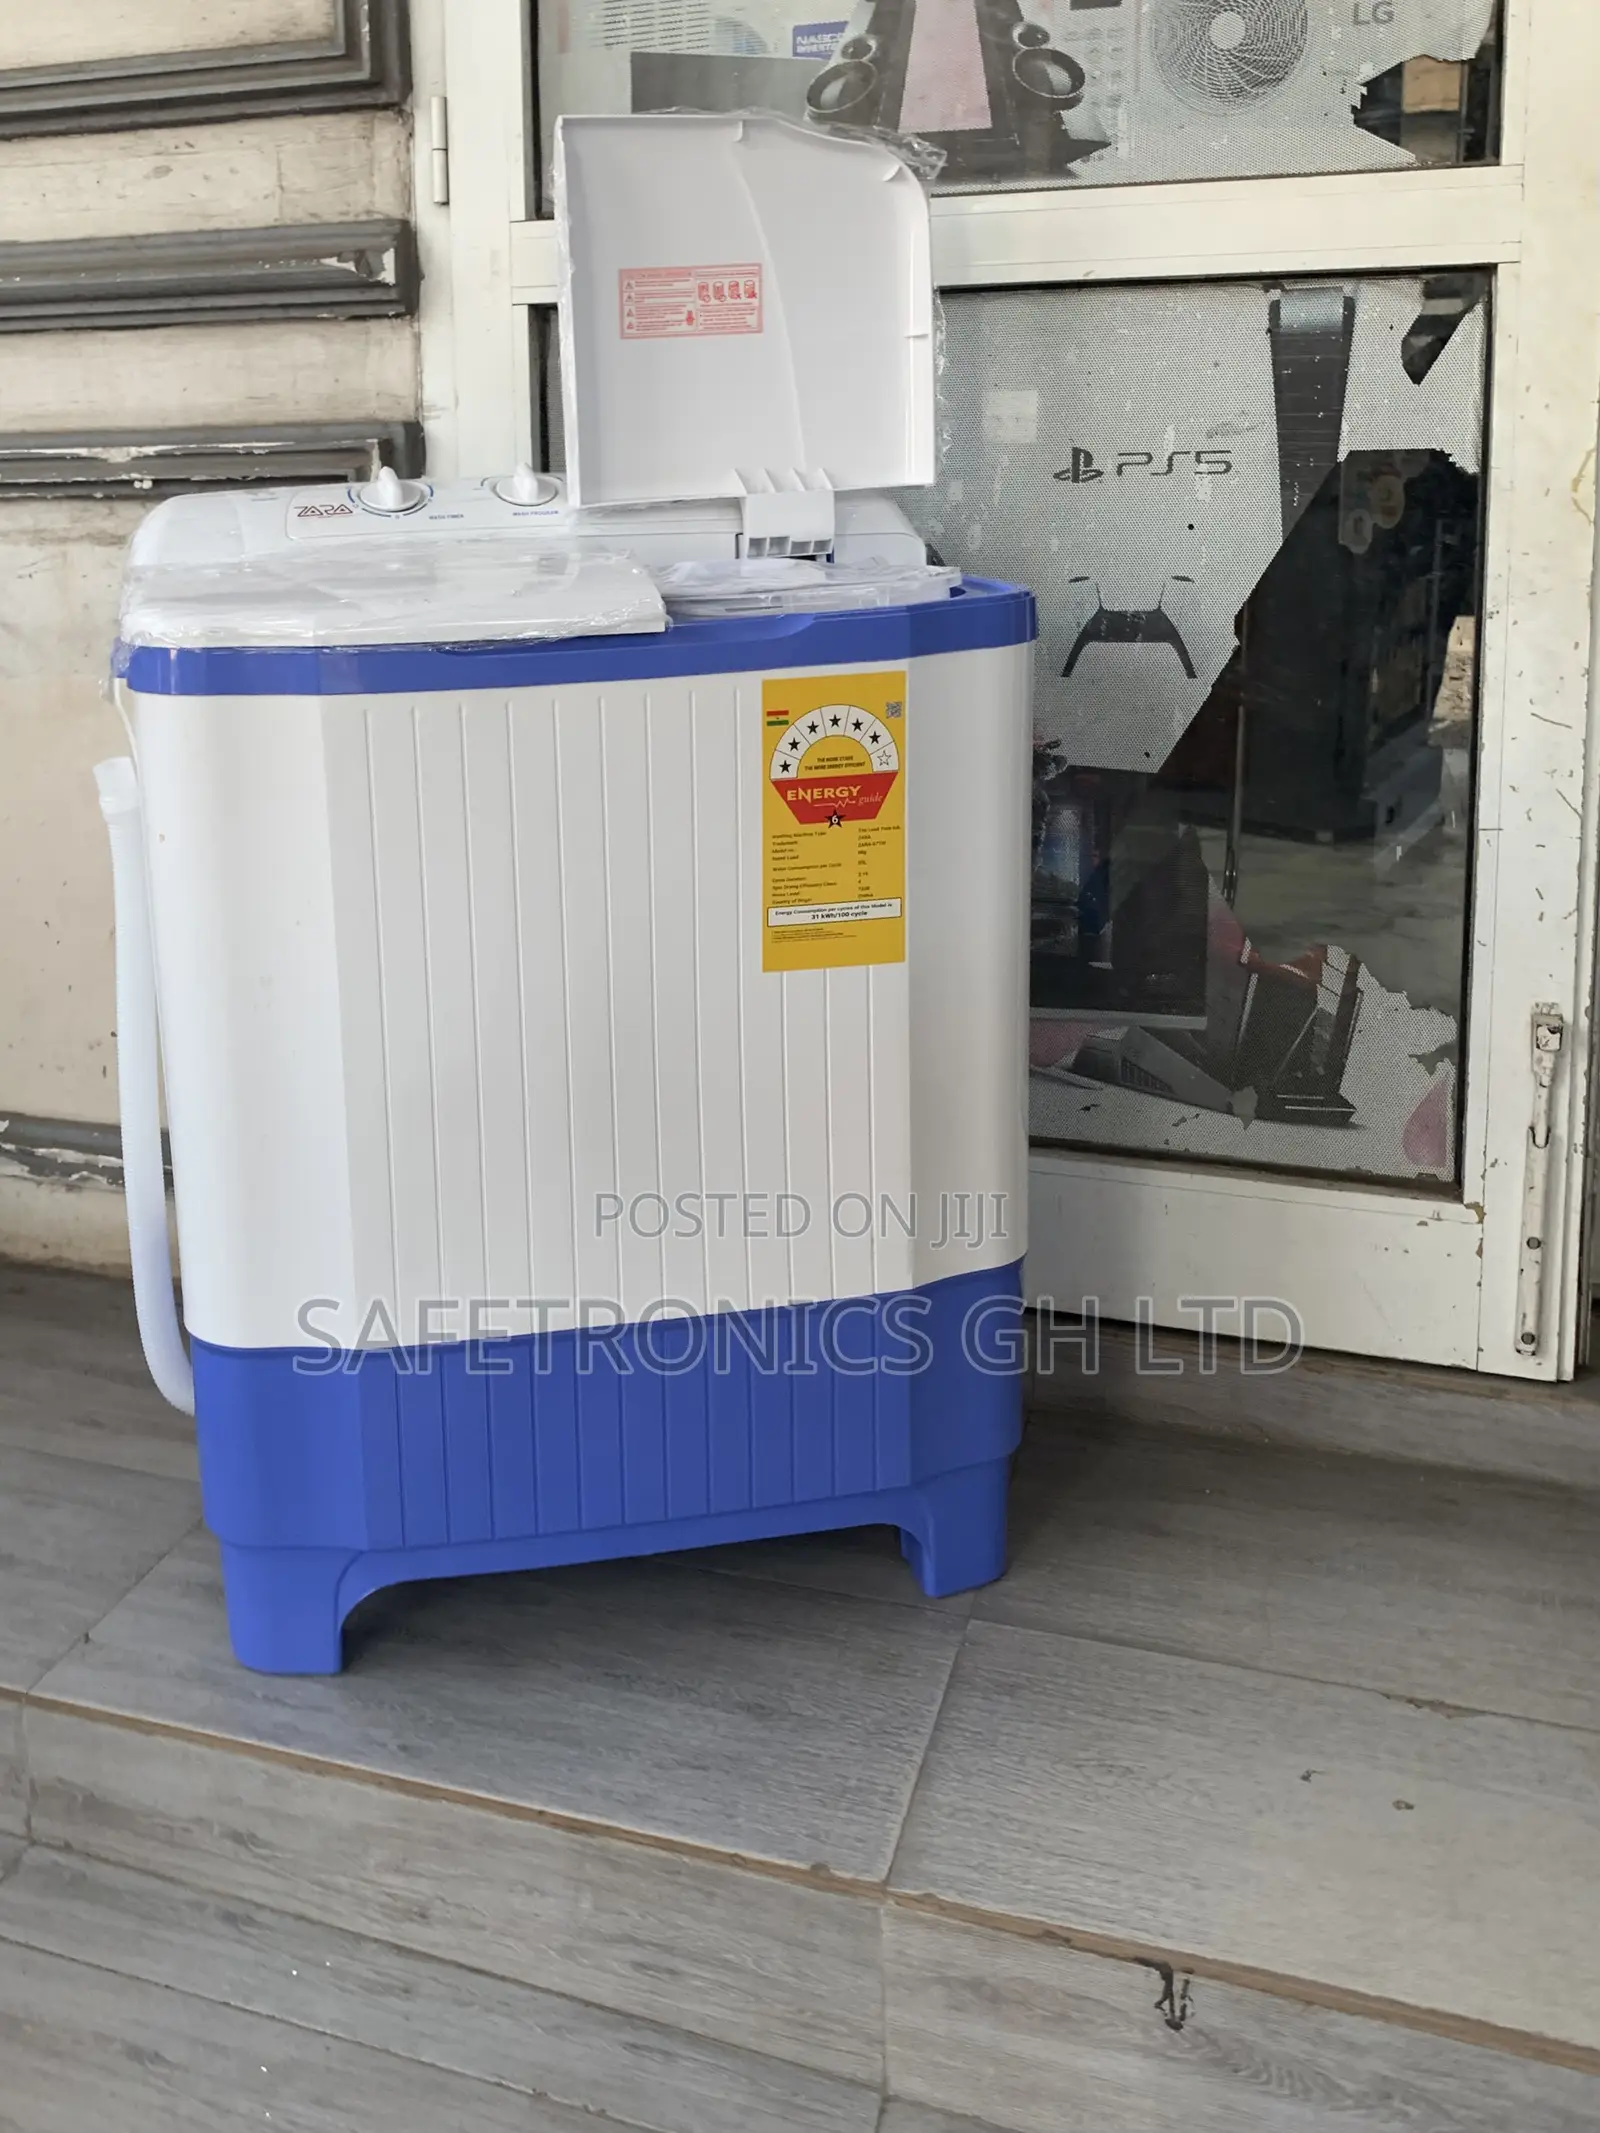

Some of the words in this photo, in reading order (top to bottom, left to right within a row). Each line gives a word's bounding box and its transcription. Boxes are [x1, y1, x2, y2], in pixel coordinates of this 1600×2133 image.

[1352, 0, 1395, 25] LG
[1116, 449, 1233, 477] PS5
[294, 503, 353, 518] ZARA
[786, 785, 862, 803] ENERGY
[831, 815, 839, 824] 6
